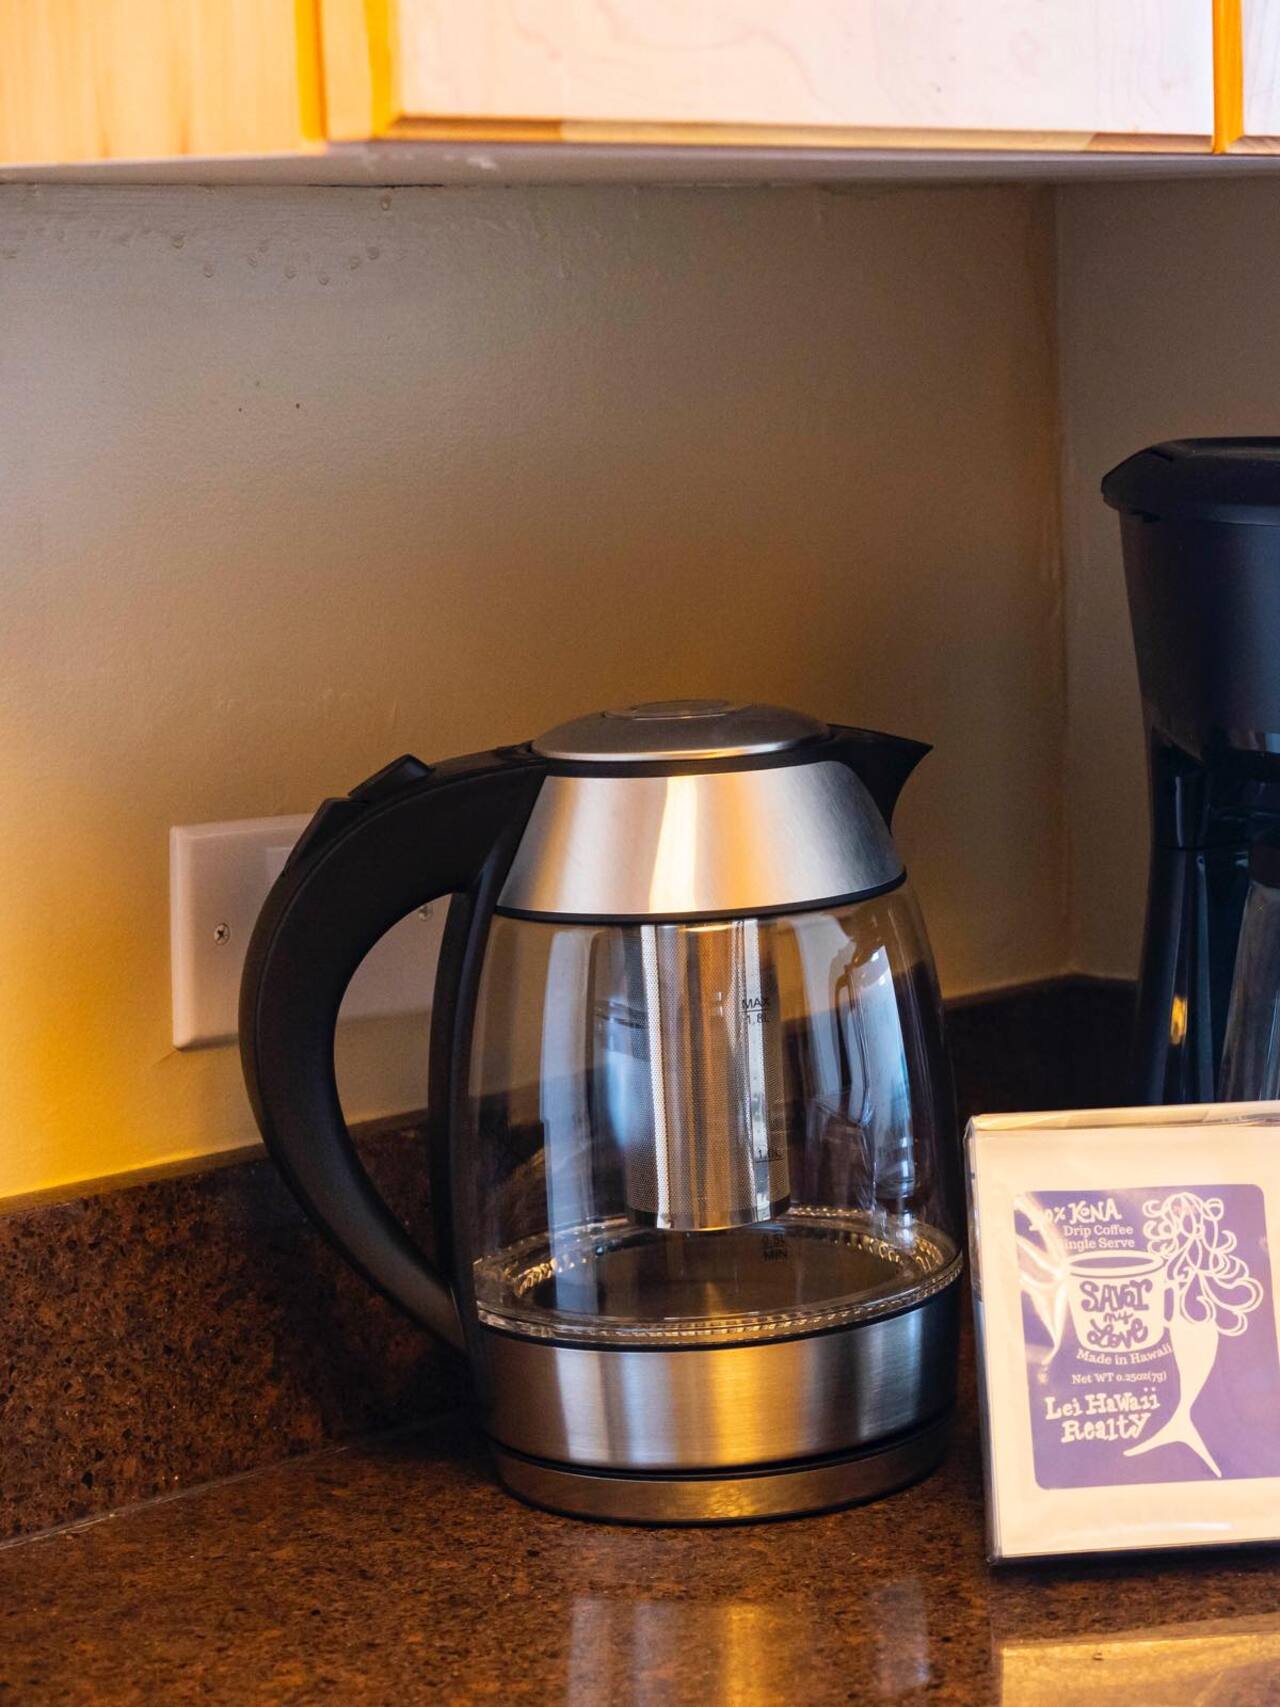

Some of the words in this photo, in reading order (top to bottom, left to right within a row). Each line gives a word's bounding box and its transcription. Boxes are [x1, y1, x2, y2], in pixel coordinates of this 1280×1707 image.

[1063, 1224, 1092, 1240] Drip
[1093, 1224, 1134, 1236] Coffee
[1062, 1237, 1097, 1252] ingle
[1098, 1237, 1136, 1249] Serve
[1076, 1348, 1113, 1365] Made
[1114, 1354, 1128, 1366] in
[1129, 1342, 1173, 1365] Hawaii
[1071, 1374, 1093, 1385] Net
[1093, 1371, 1115, 1384] WT
[1044, 1396, 1083, 1420] Lei
